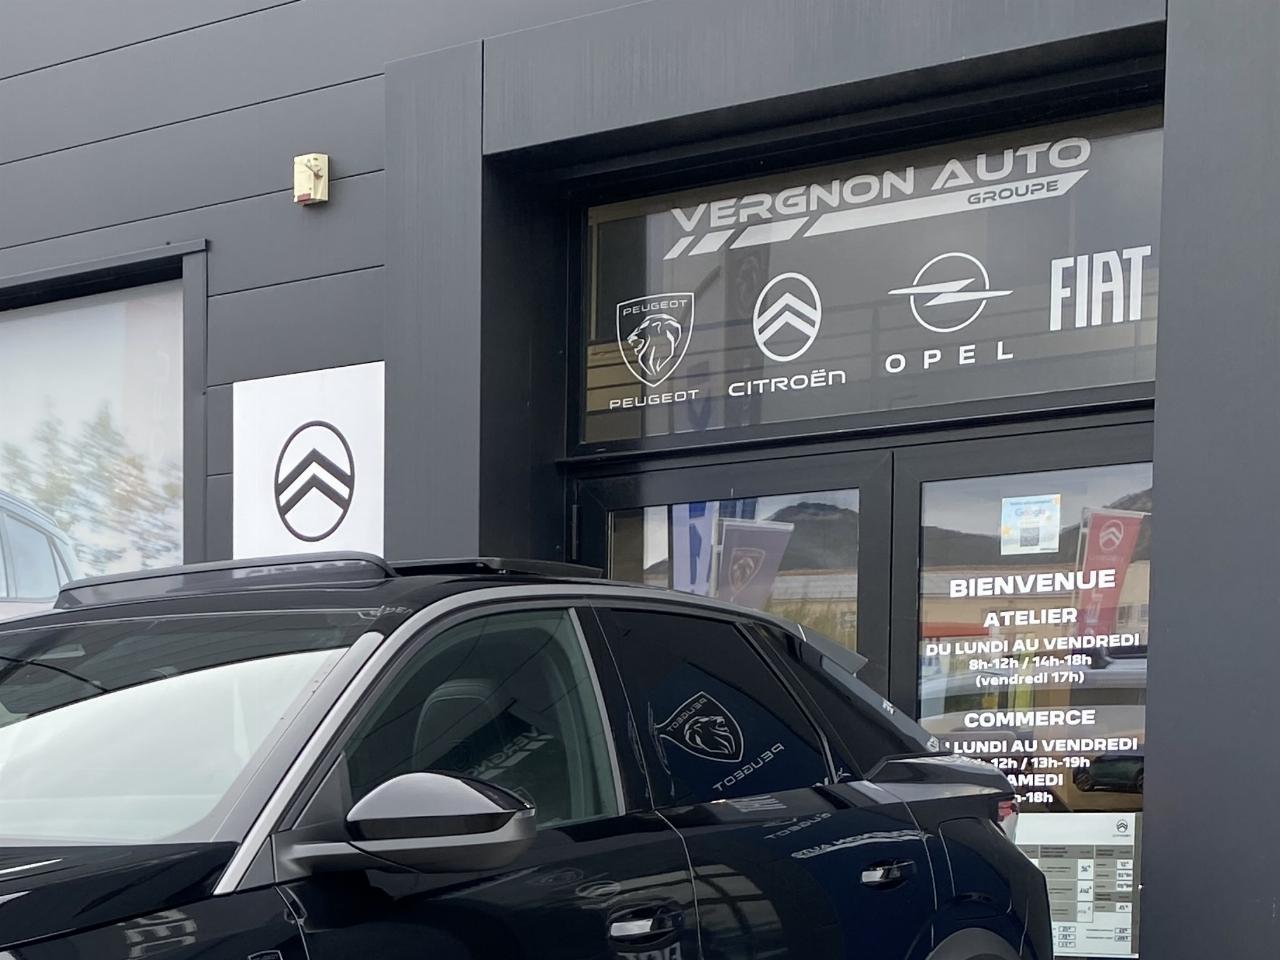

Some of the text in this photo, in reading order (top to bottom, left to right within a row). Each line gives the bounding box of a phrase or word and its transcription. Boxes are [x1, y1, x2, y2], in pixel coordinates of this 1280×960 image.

[671, 138, 1092, 231] VERGNON AUTO
[968, 179, 1060, 204] GROUPE
[1050, 246, 1152, 331] FIAT
[622, 299, 687, 316] PEUGEOT
[885, 341, 1014, 372] OPEL
[609, 389, 700, 409] PEUGEOT
[950, 569, 1116, 598] BIENVENUE
[983, 607, 1078, 628] ATELIER
[926, 633, 1140, 656] DU LUNDI AU VENDREDI
[969, 657, 1019, 671] 8h-12h
[1033, 654, 1092, 667] 14h-18h
[975, 671, 1085, 687] (vendredi 17h)
[964, 710, 1096, 728] COMMERCE
[954, 740, 1007, 754] LUNDI
[1011, 739, 1038, 752] AU
[1041, 738, 1138, 751] VENDREDI
[1032, 756, 1090, 769] 13h-19h
[1006, 773, 1064, 787] AMEDI
